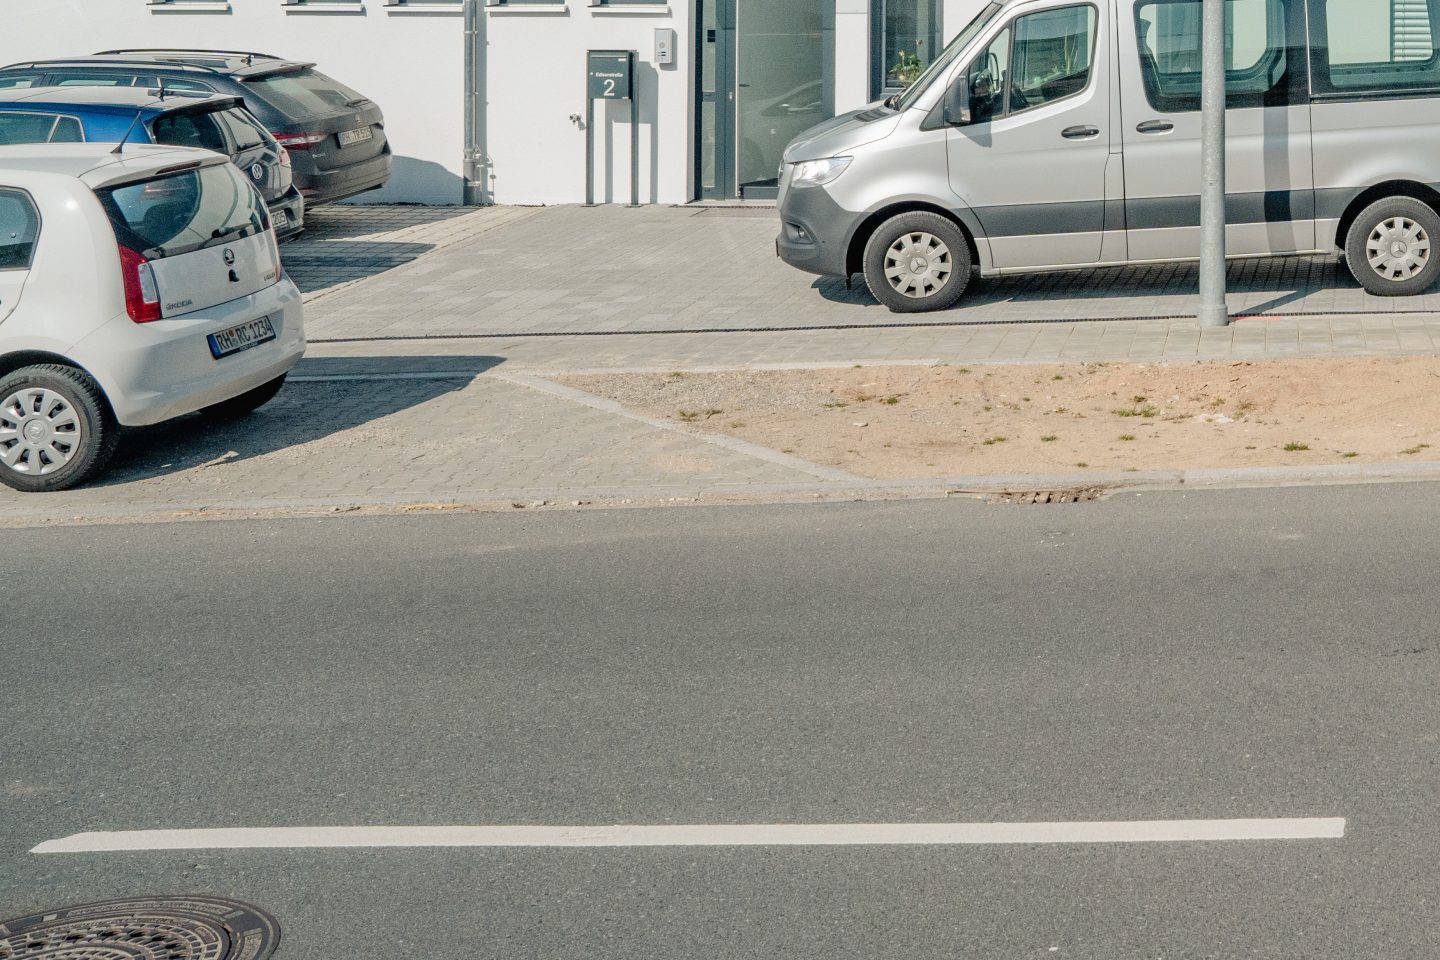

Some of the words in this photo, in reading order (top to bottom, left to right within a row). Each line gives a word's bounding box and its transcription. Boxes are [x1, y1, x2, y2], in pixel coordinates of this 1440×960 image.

[603, 79, 615, 97] 2
[215, 331, 233, 351] RH
[234, 325, 251, 344] RC
[249, 319, 273, 339] 1234
